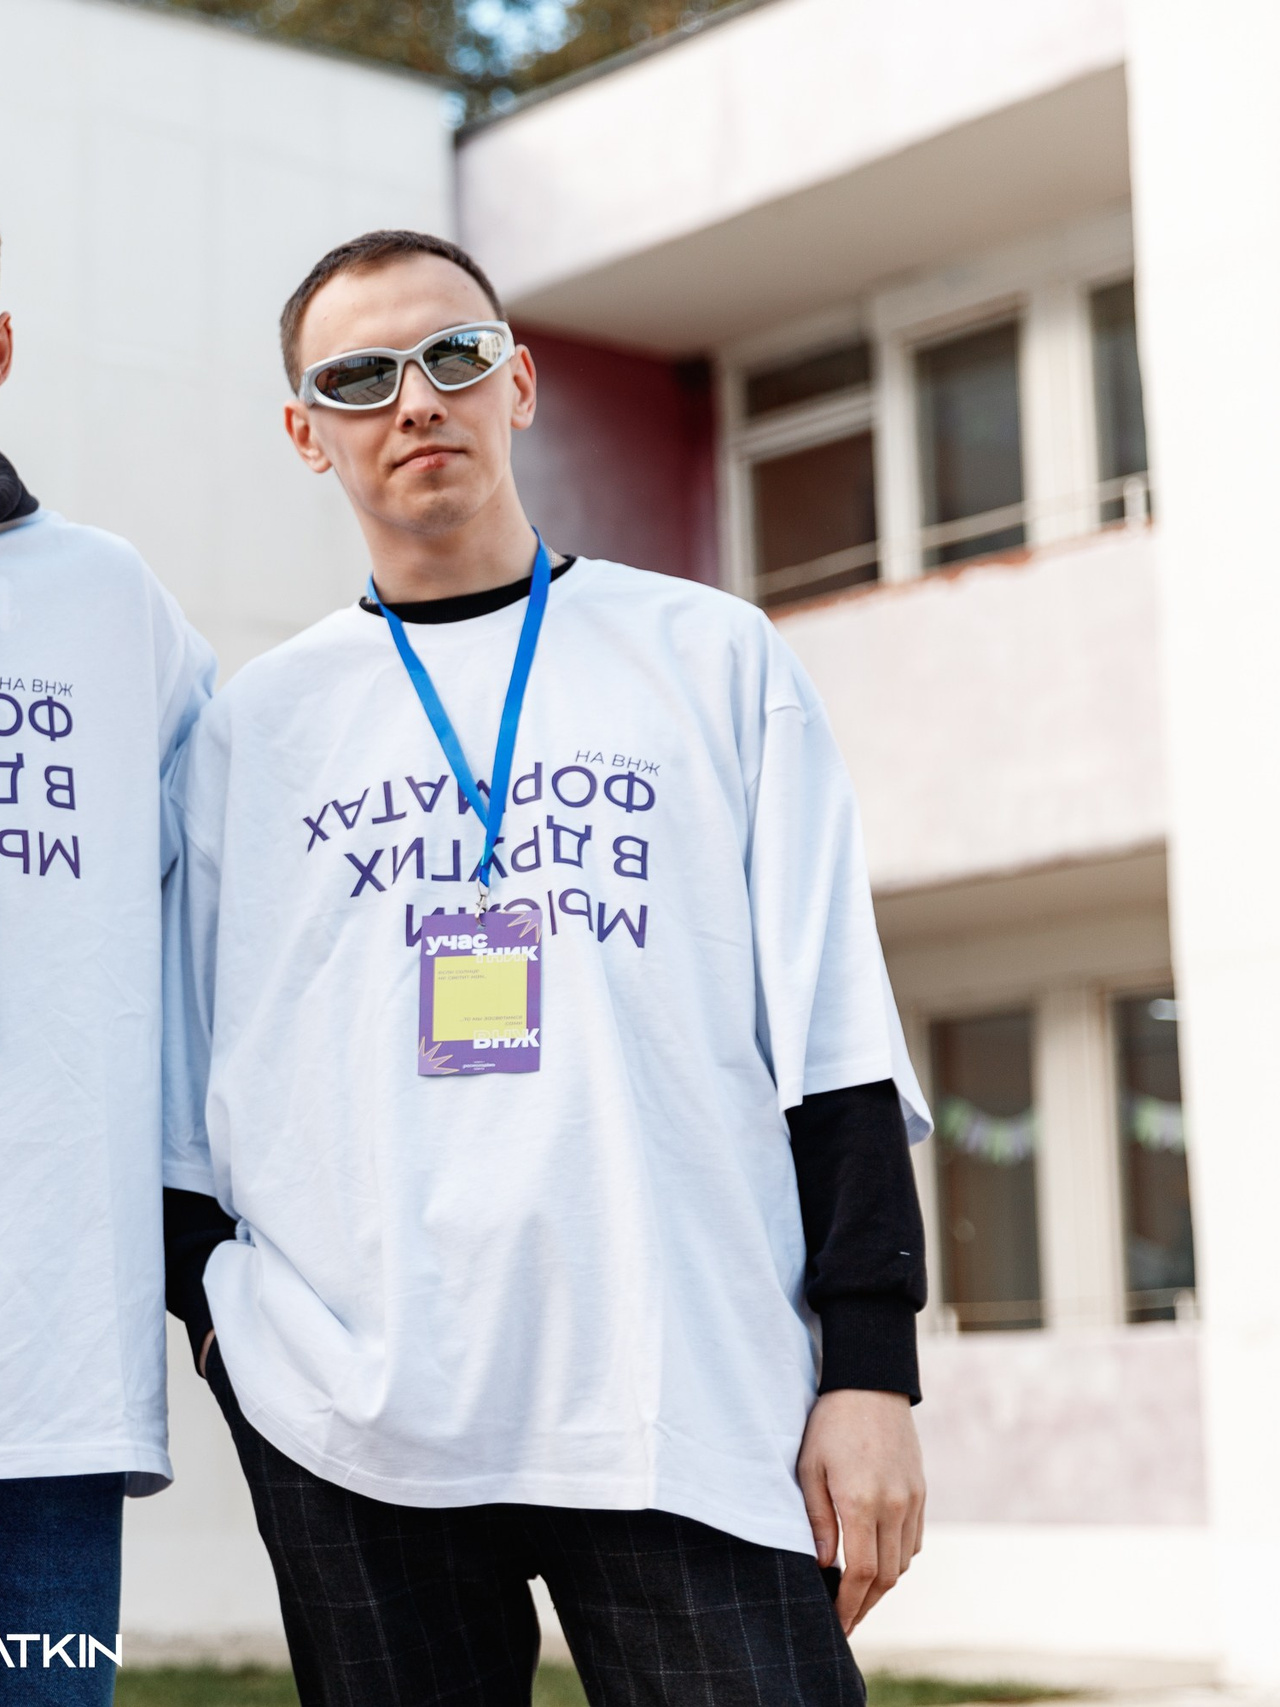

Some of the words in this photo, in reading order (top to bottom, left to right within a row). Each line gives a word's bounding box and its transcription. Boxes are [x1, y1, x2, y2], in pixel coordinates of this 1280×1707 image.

[0, 677, 25, 692] НА
[32, 678, 73, 698] ВНЖ
[575, 750, 604, 765] НА
[612, 753, 661, 777] ВНЖ
[44, 765, 76, 810] В
[613, 835, 648, 881] В
[425, 933, 488, 956] учас
[472, 945, 539, 964] тник
[473, 1028, 540, 1050] ВНЖ
